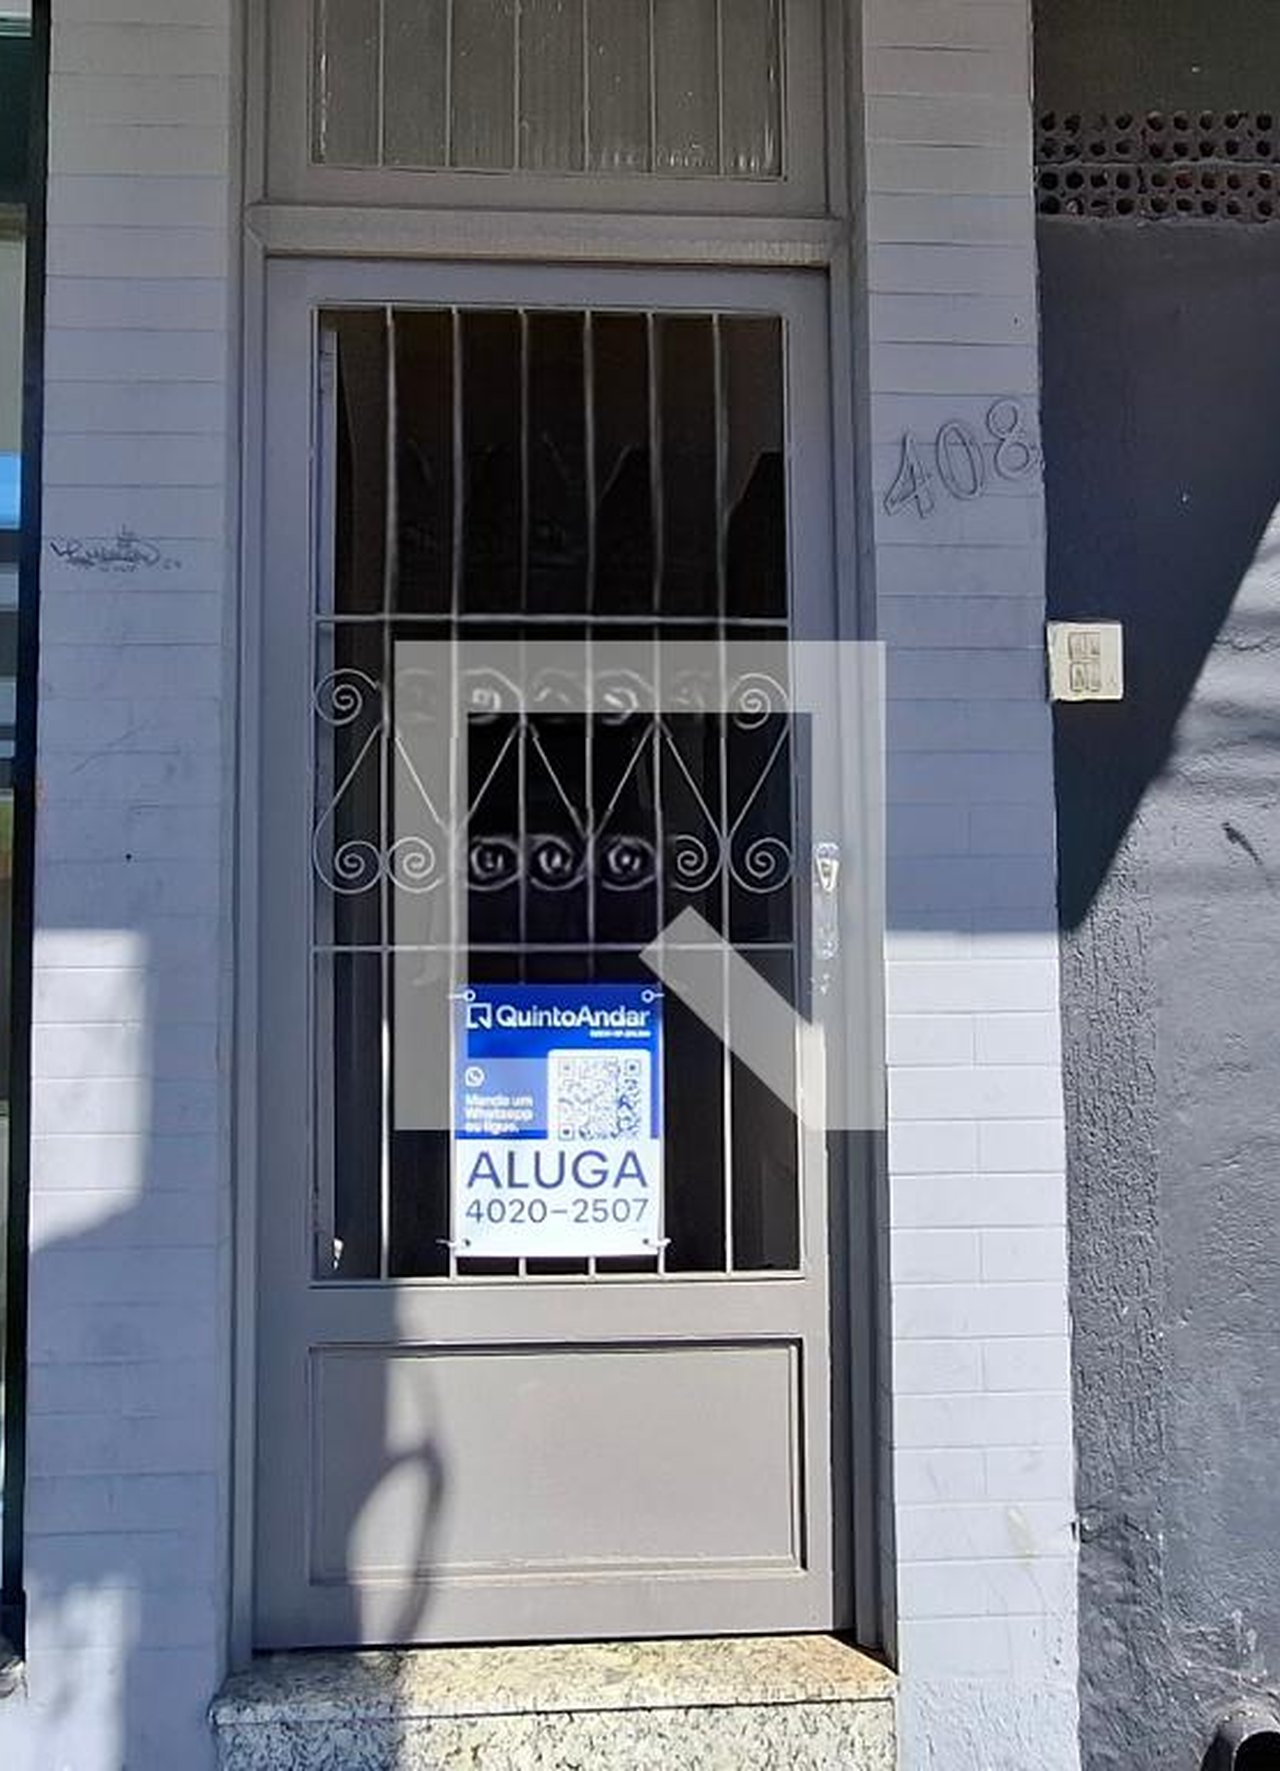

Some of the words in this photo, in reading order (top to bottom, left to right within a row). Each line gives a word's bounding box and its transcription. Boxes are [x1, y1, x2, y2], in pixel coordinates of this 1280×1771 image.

[883, 396, 1039, 520] 408
[496, 1005, 650, 1028] QuintoAndar
[467, 1151, 648, 1189] ALUGA
[466, 1199, 649, 1223] 4020-2507
